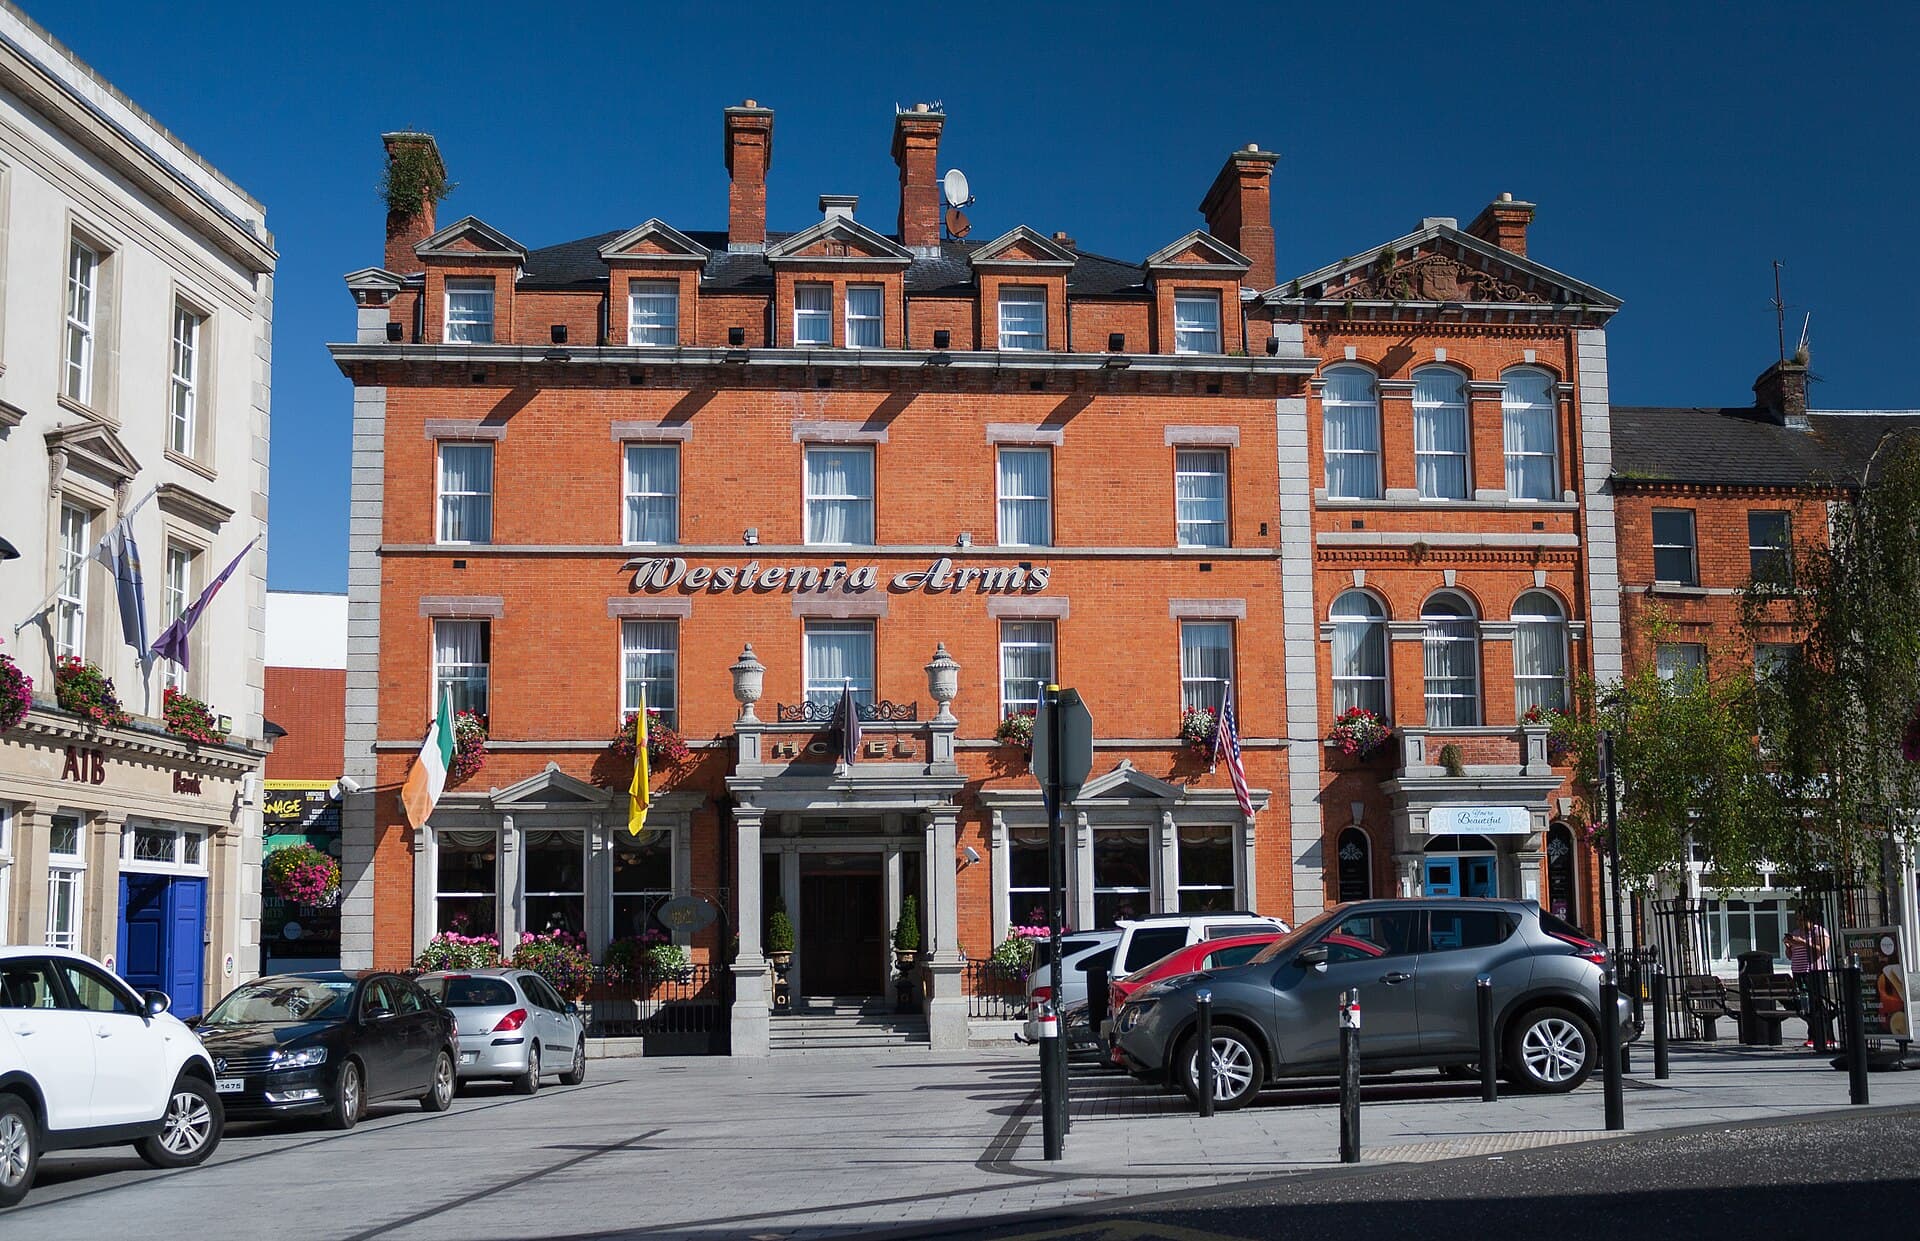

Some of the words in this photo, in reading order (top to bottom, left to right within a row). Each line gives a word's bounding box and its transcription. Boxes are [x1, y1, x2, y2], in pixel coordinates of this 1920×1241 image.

[617, 557, 879, 592] Westenra
[890, 557, 1052, 592] Arms
[776, 740, 917, 755] HOEL
[61, 745, 106, 786] AIB
[1457, 811, 1502, 826] Beautiful
